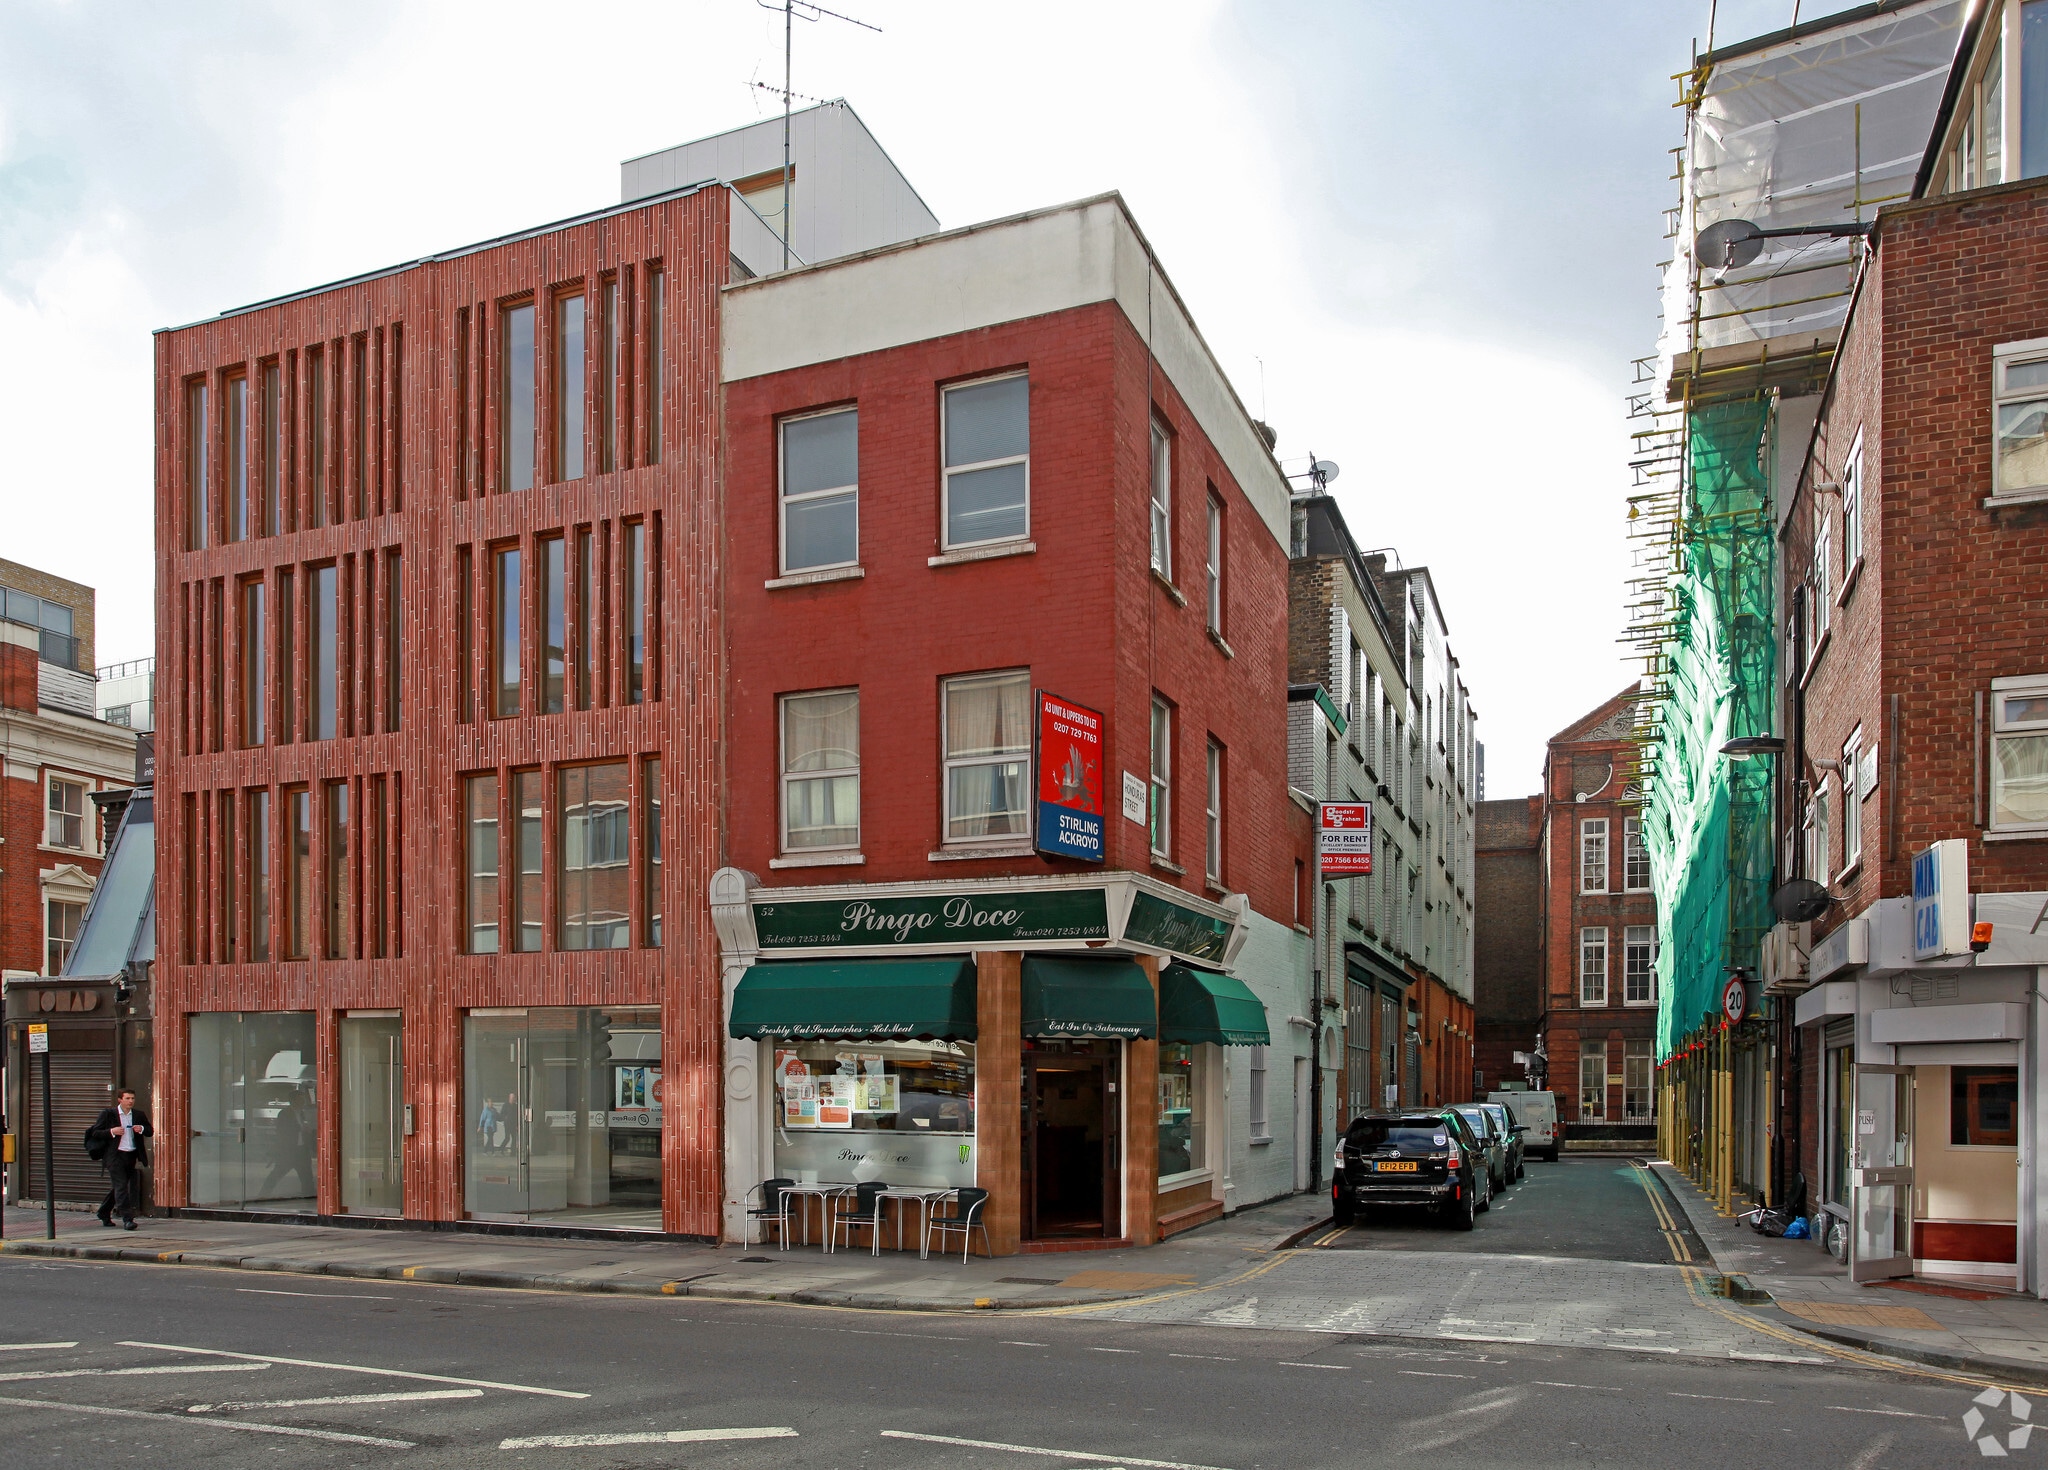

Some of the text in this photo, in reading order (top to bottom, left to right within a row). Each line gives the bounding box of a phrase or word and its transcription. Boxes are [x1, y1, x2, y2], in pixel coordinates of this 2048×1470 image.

[1044, 701, 1052, 713] A3
[1052, 704, 1062, 717] UNIT
[1066, 708, 1084, 724] UPPERS
[1084, 715, 1090, 726] TO
[1054, 722, 1098, 744] 0207 729 7763
[1124, 782, 1145, 804] HONDURAS
[1124, 797, 1138, 813] STREET
[1059, 814, 1099, 835] STIRLING
[1333, 814, 1362, 828] graham
[1058, 831, 1098, 850] ACKROYD
[760, 907, 774, 916] 52
[840, 897, 1024, 942] Pingo Doce
[1057, 927, 1080, 936] 7253
[1082, 925, 1107, 936] 4844
[1916, 903, 1938, 951] CAB
[798, 935, 818, 943] 7253
[820, 934, 840, 942] 5443
[1728, 990, 1742, 1010] 20
[757, 1024, 790, 1036] Freshly
[792, 1024, 810, 1034] Cut
[810, 1024, 863, 1034] Sandwiches
[870, 1024, 888, 1033] Hot
[886, 1023, 914, 1032] Meal
[1048, 1021, 1142, 1036] Eat In Or Takeaway
[1858, 1116, 1874, 1124] PUSH
[1380, 1162, 1397, 1170] EF12
